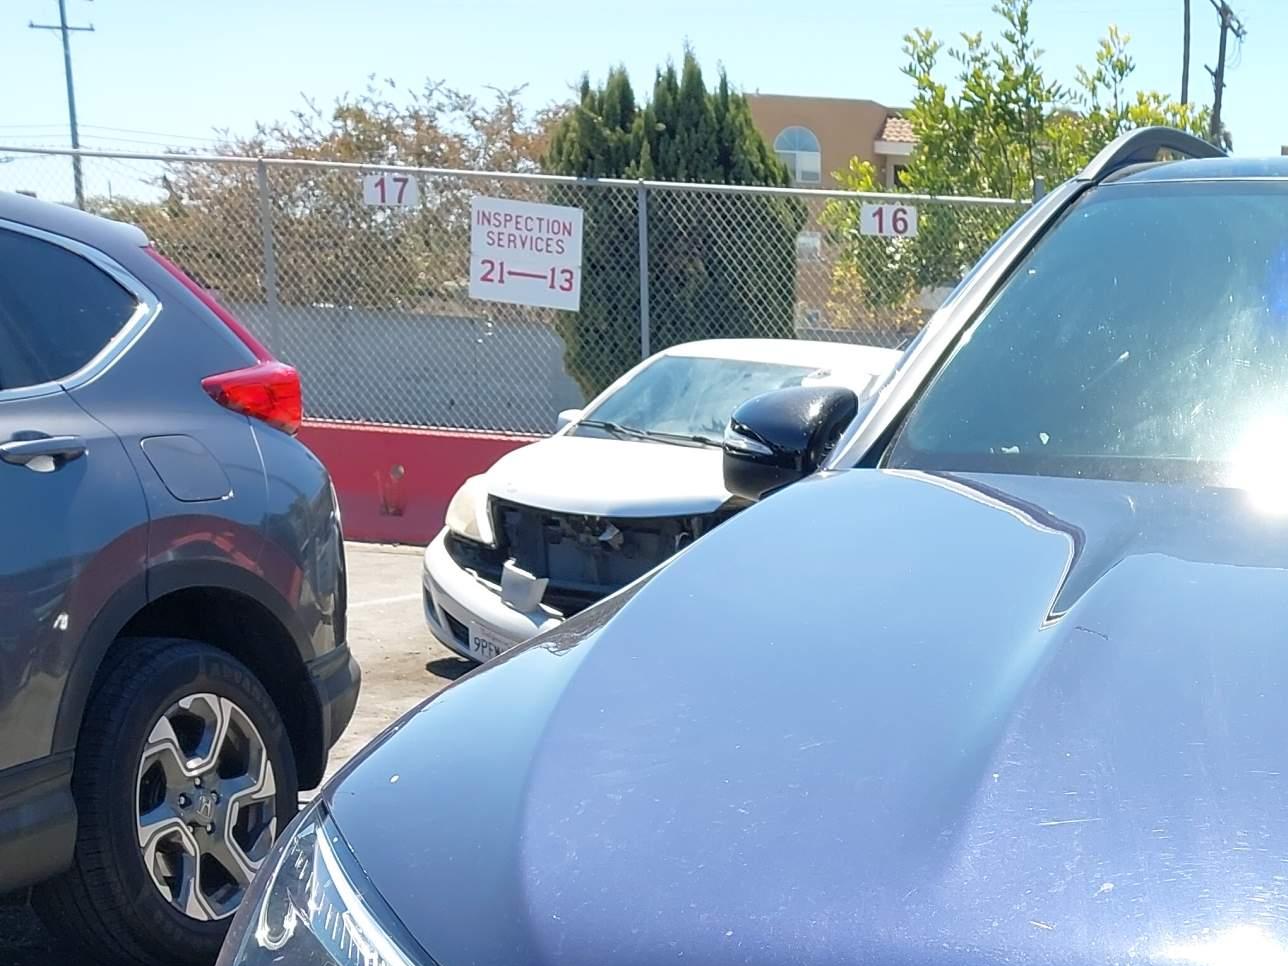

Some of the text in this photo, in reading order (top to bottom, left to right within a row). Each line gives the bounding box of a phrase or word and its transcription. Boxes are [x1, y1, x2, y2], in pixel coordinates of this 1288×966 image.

[374, 177, 408, 203] 17
[476, 209, 573, 237] INSPECTION
[872, 206, 908, 234] 16
[486, 230, 565, 254] SERVICES
